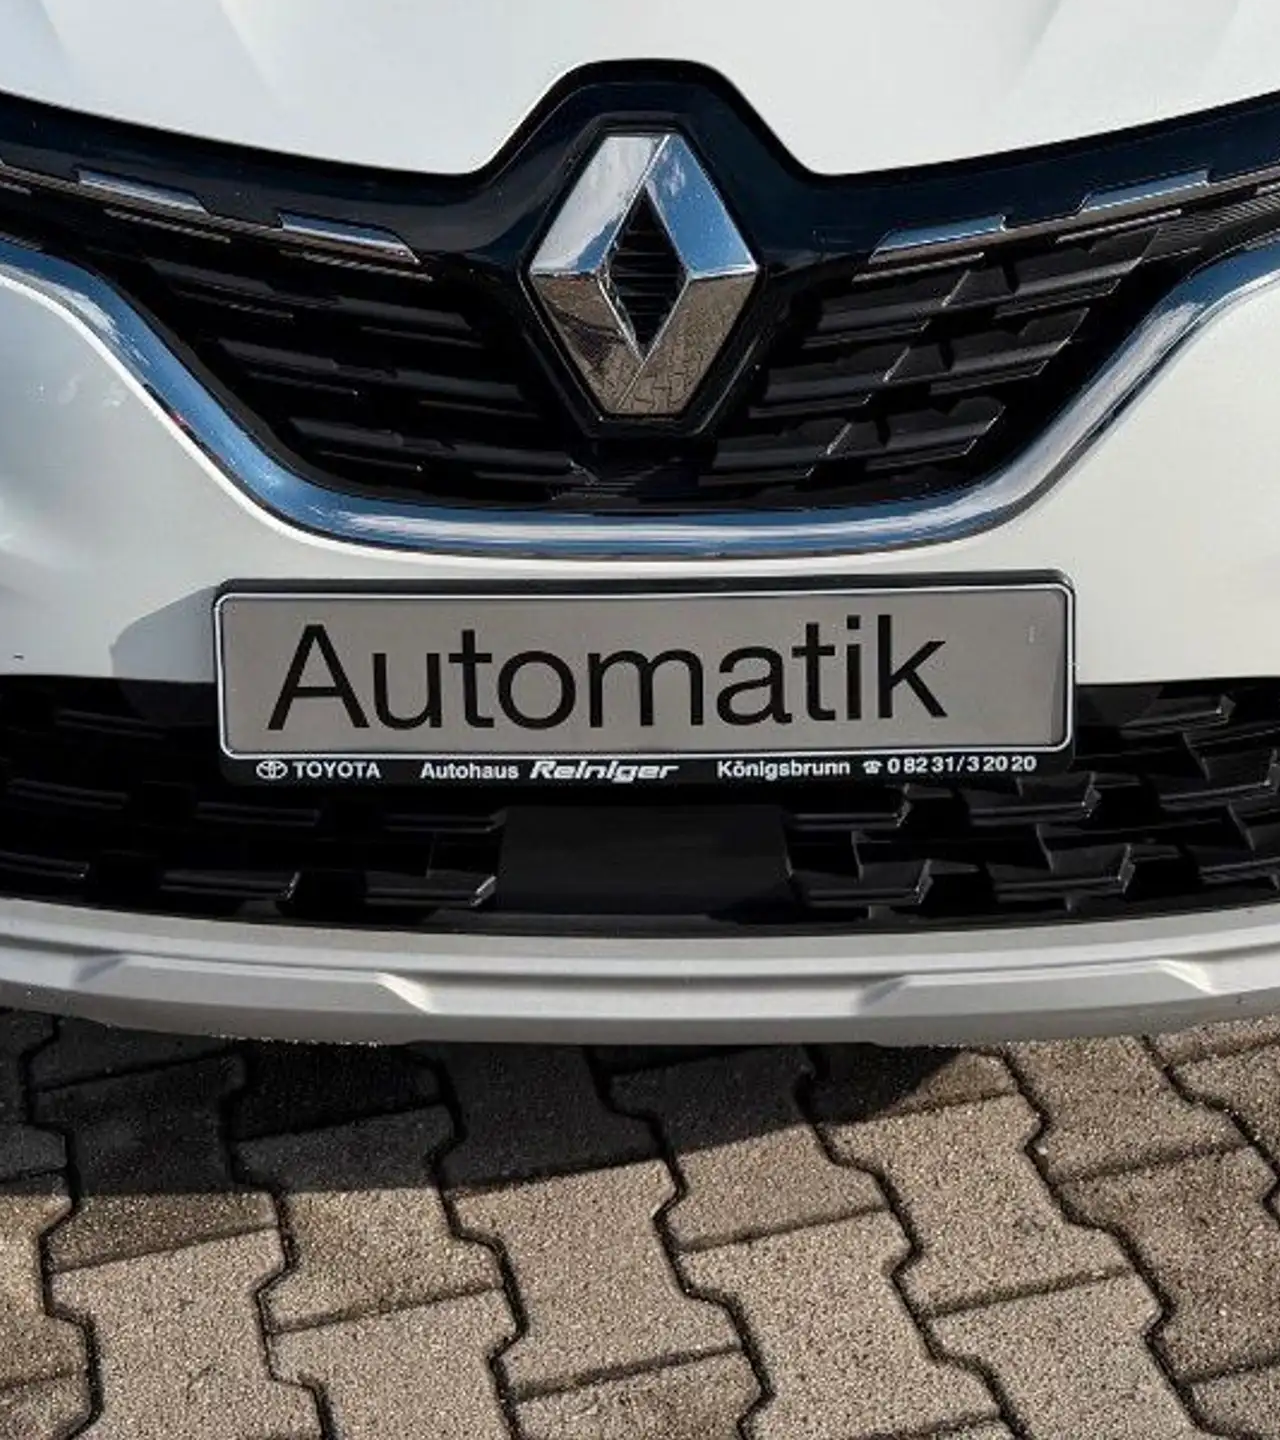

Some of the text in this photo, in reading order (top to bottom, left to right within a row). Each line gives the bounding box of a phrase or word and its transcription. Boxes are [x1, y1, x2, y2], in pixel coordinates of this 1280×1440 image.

[267, 614, 948, 731] Automatik
[293, 761, 381, 779] TOYOTA
[420, 762, 520, 780] Autohaus
[529, 760, 680, 783] Reiniger
[717, 760, 851, 781] Königsbrunn
